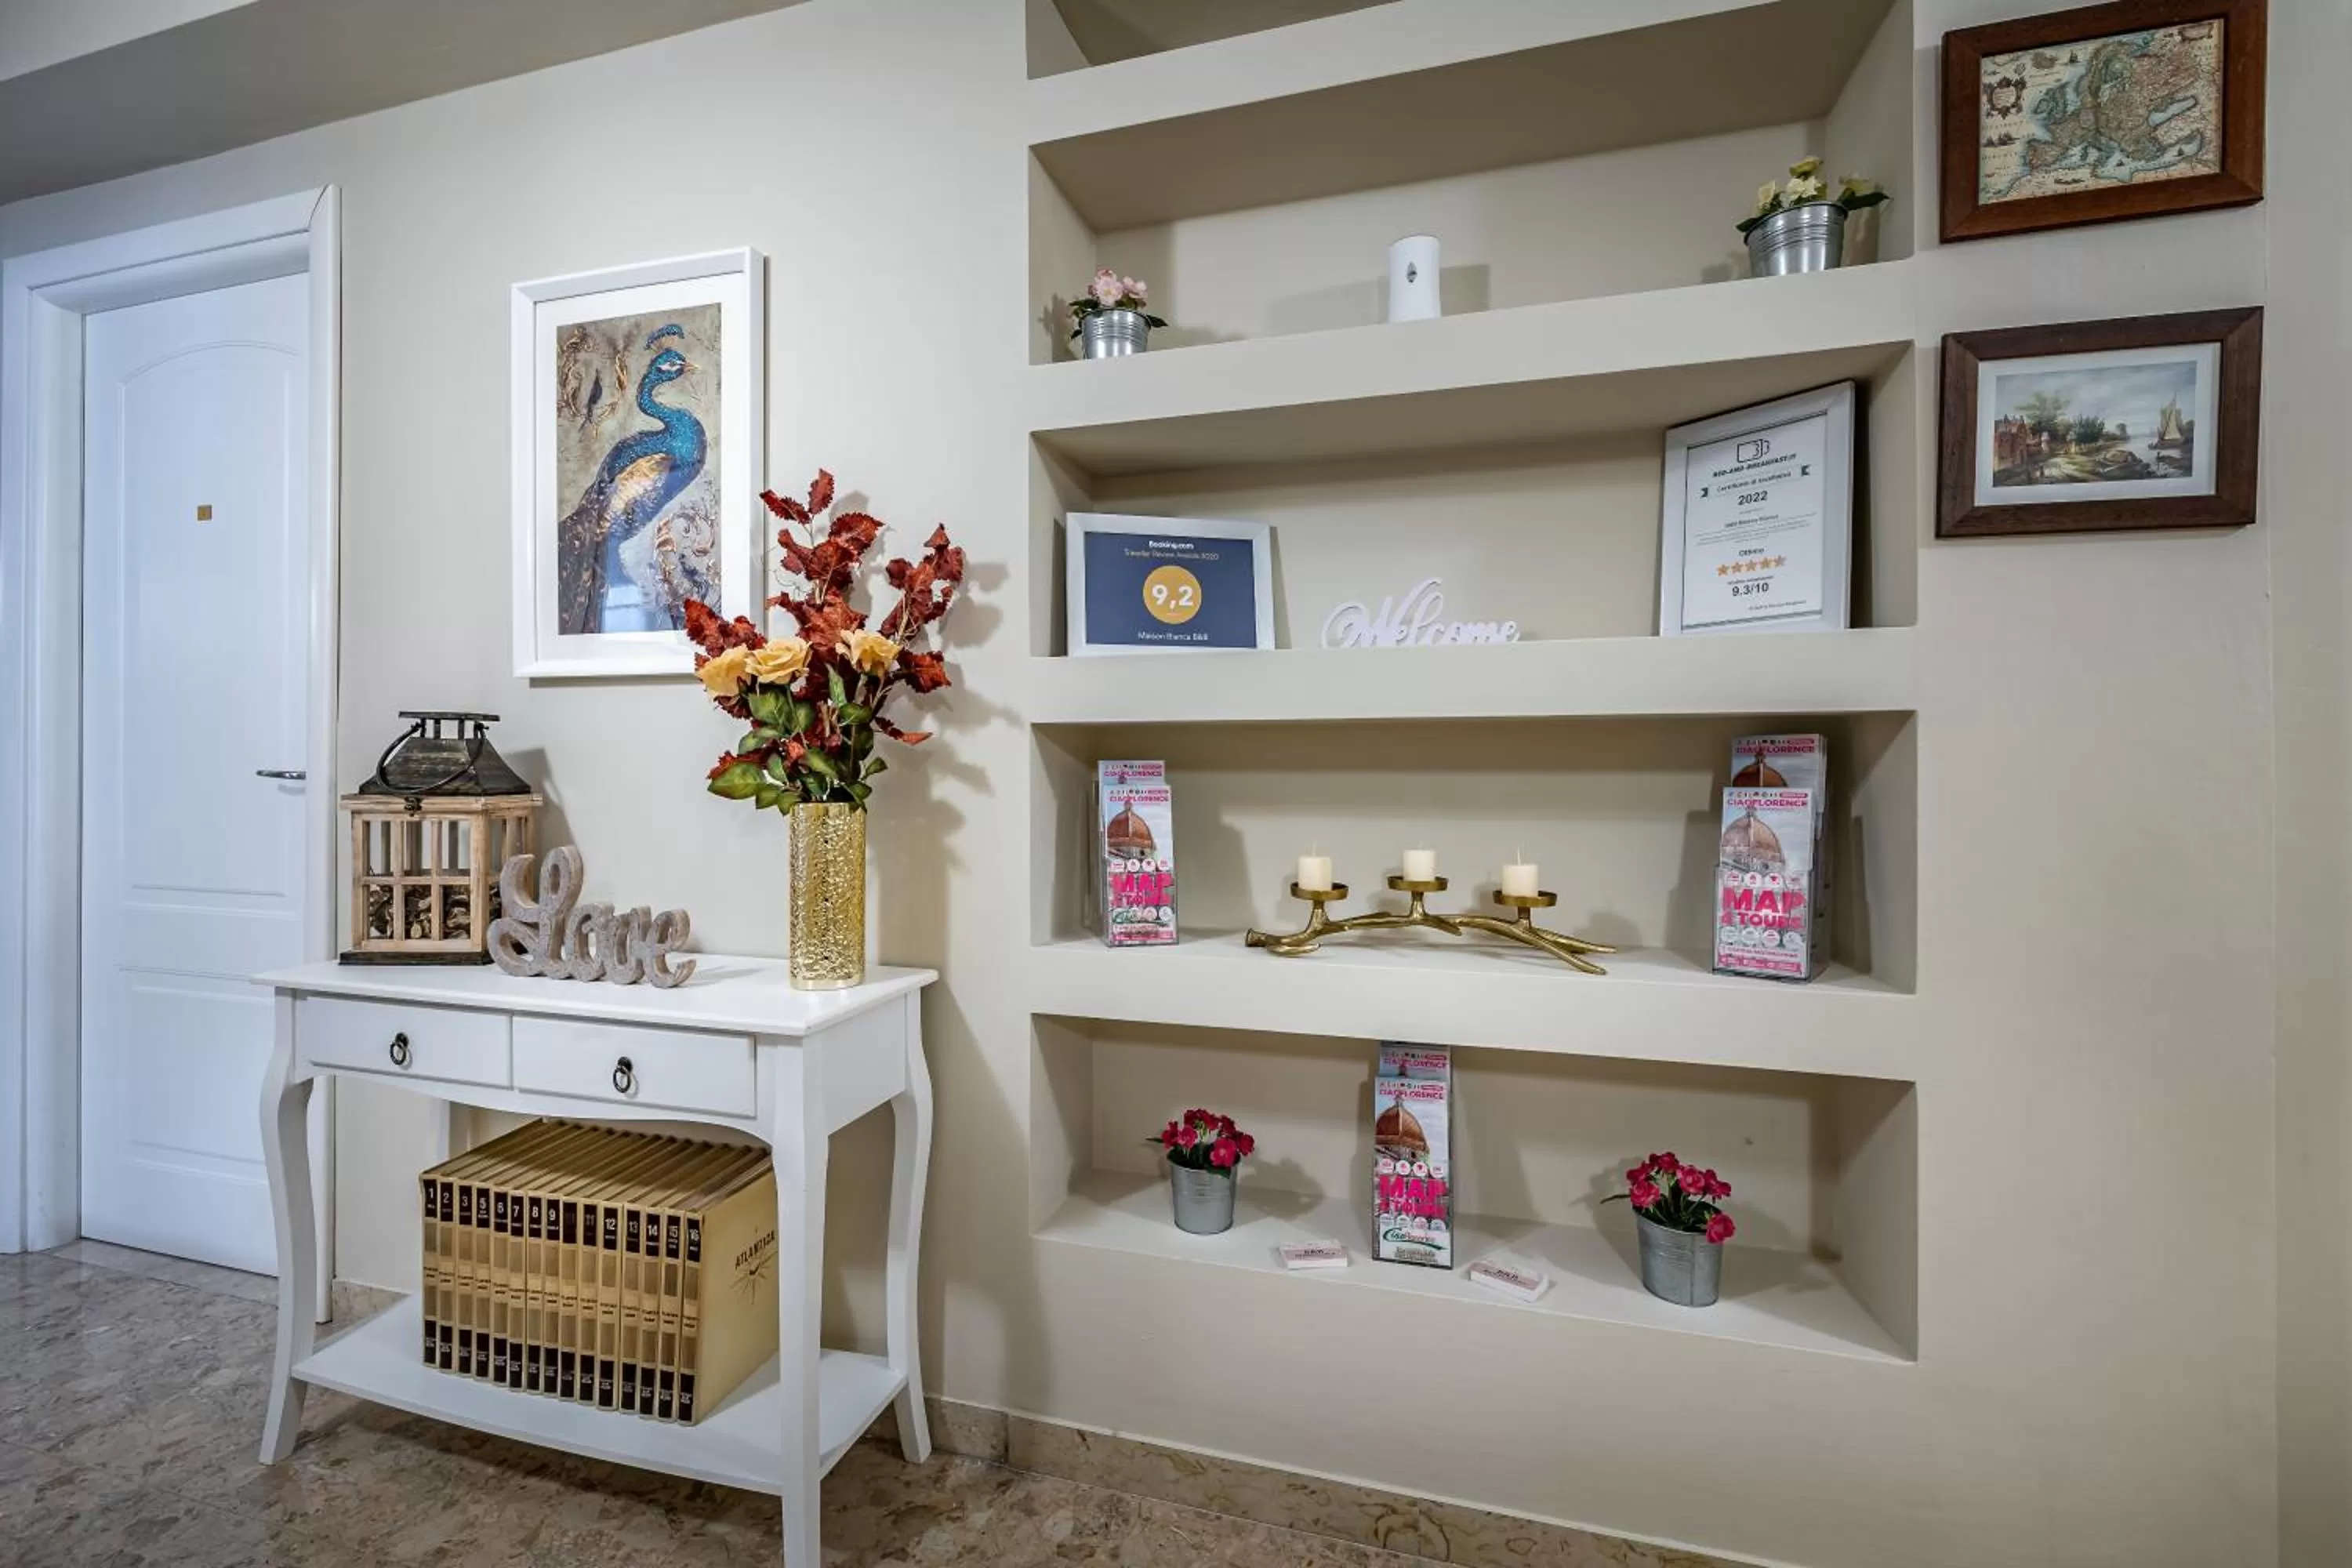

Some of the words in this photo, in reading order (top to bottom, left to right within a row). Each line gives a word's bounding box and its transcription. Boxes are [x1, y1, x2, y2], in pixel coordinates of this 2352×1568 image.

[1738, 491, 1768, 506] 2022
[1732, 583, 1769, 597] 9.3/10
[1152, 584, 1193, 610] 9,2
[1722, 887, 1806, 915] MAP
[487, 845, 696, 988] Love
[1378, 1174, 1447, 1203] MAP
[443, 1192, 449, 1203] 2
[462, 1196, 468, 1207] 3
[479, 1197, 487, 1210] 5
[513, 1206, 520, 1217] 7
[532, 1206, 539, 1218] 8
[549, 1208, 556, 1221] 9
[586, 1214, 594, 1225] 11
[605, 1218, 616, 1230] 12
[629, 1221, 638, 1233] 13
[648, 1224, 658, 1236] 14
[668, 1225, 678, 1238] 15
